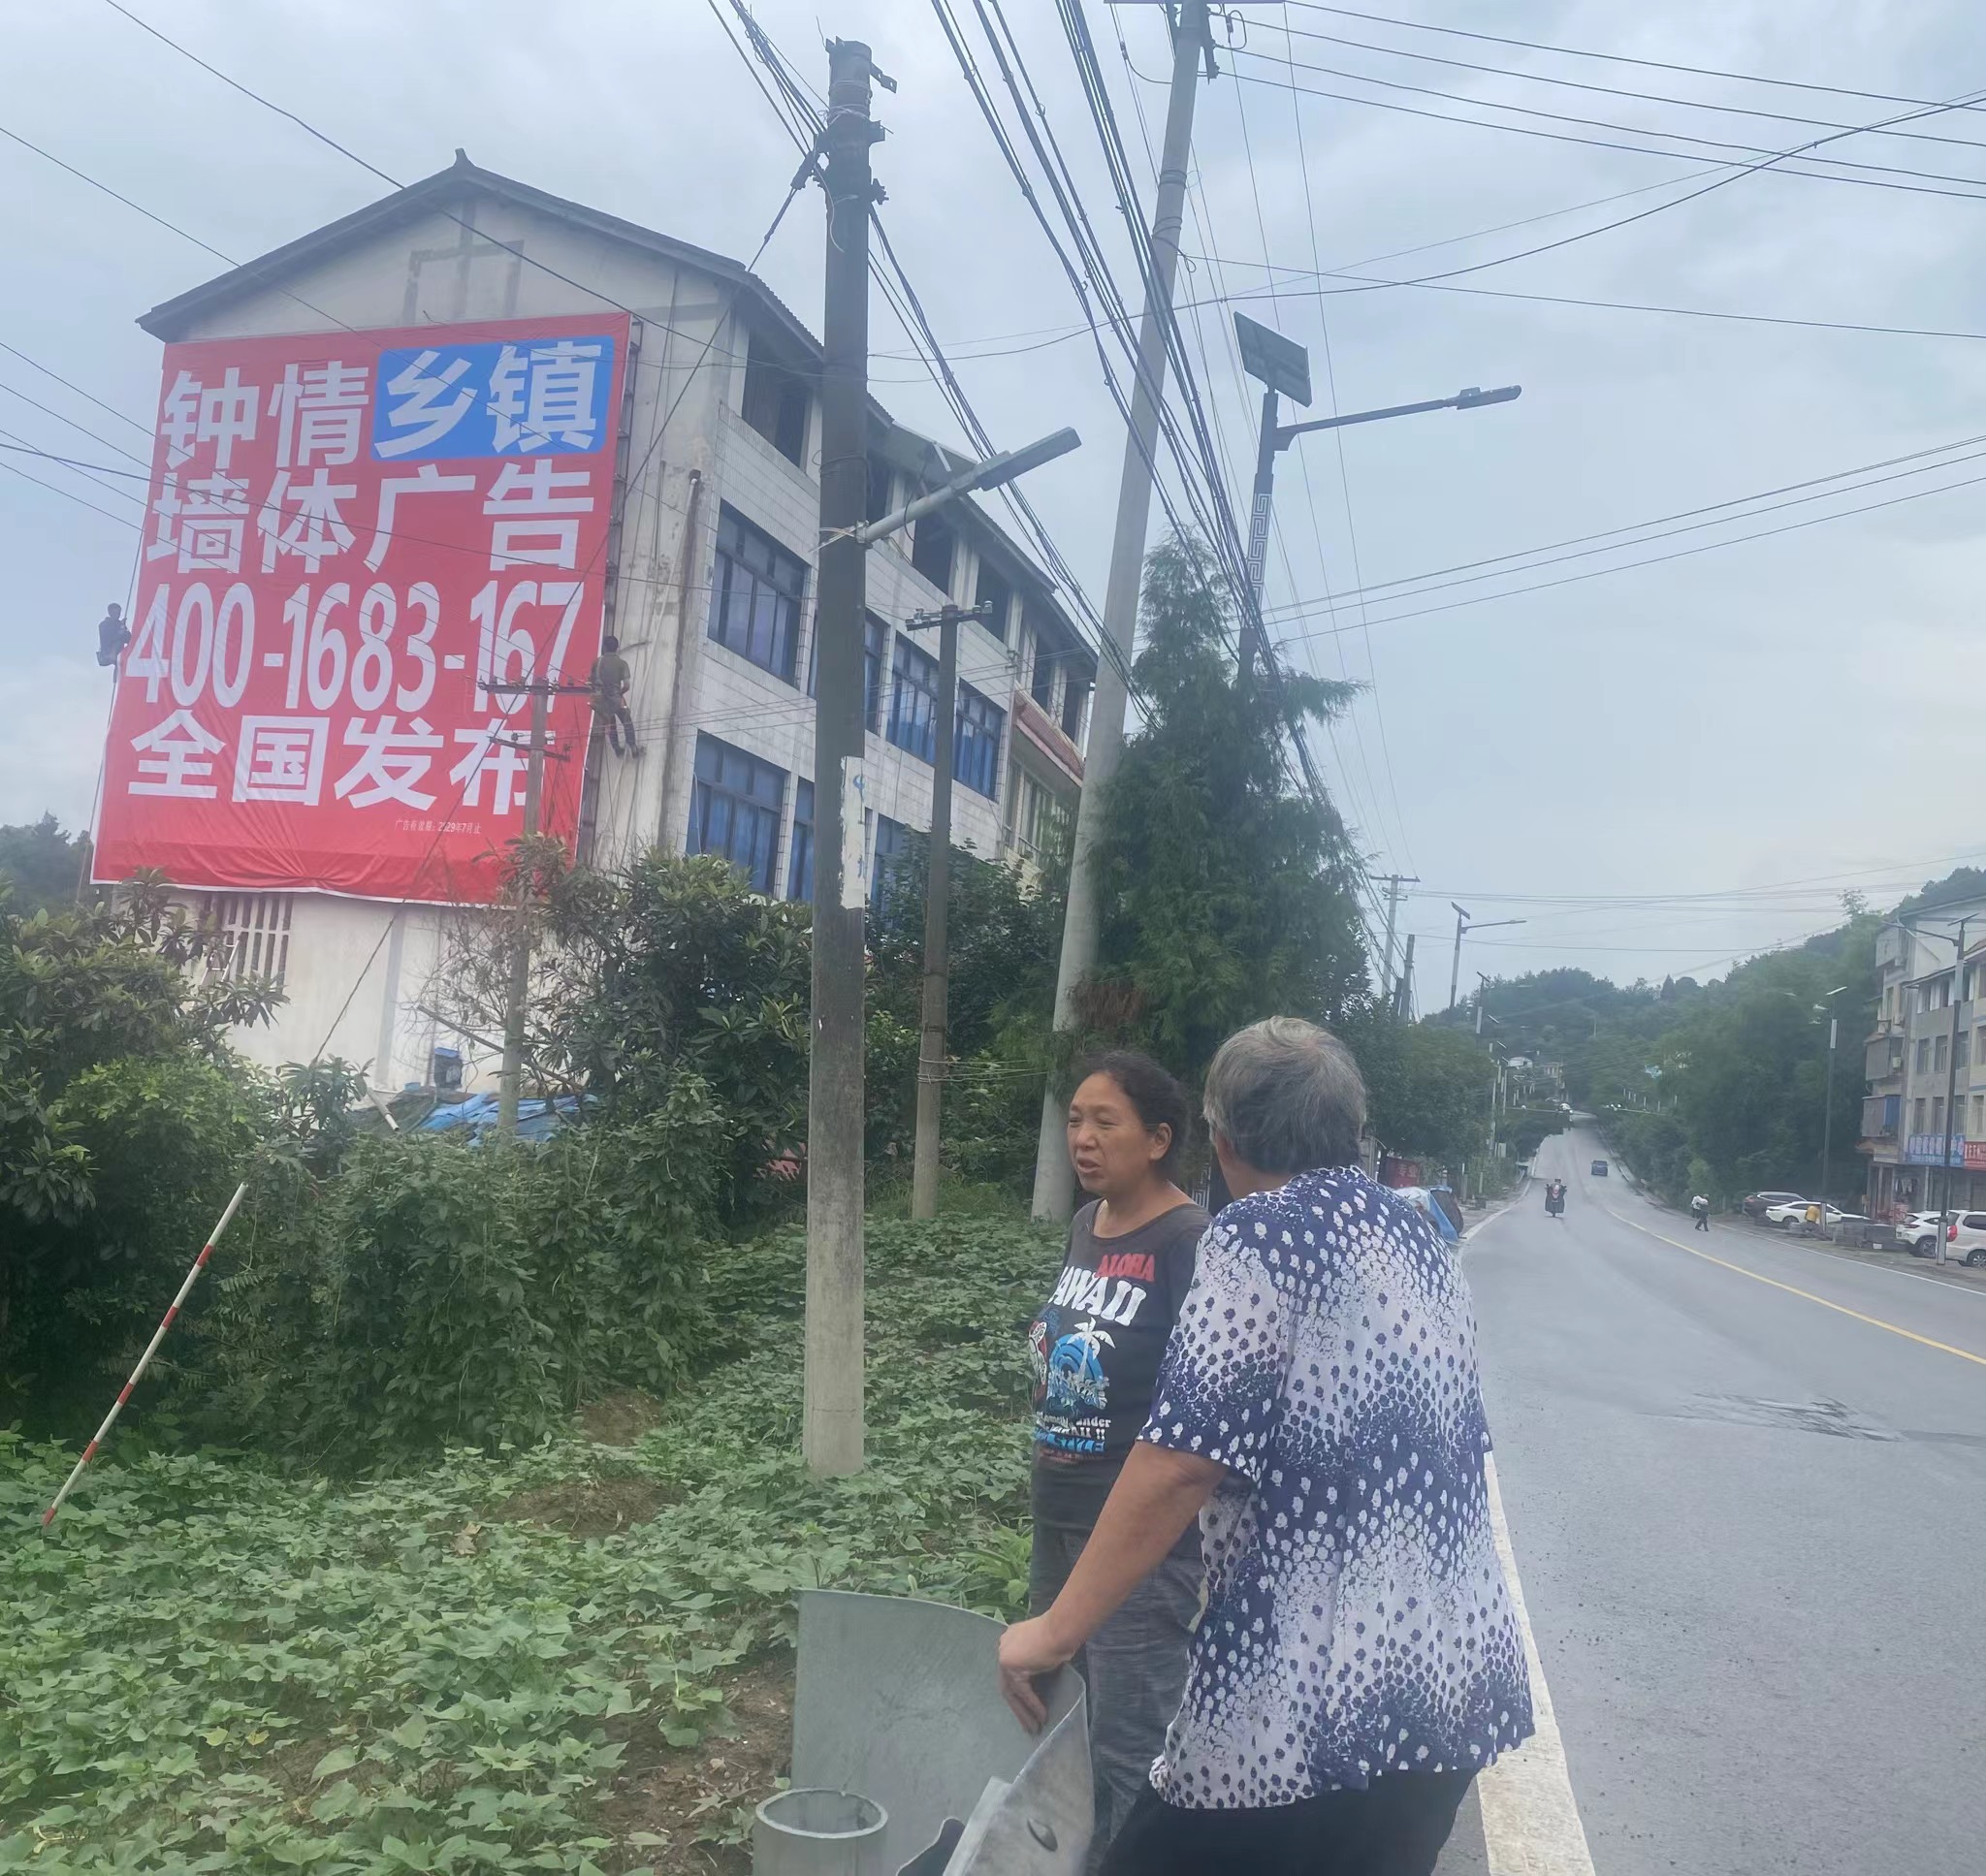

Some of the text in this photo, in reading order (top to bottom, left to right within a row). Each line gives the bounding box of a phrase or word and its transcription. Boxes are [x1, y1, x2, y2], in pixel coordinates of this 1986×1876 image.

[161, 341, 602, 469] 钟情乡镇
[146, 459, 594, 574] 墙体广告
[126, 580, 585, 715] 400-1683-167
[127, 709, 556, 815] 全国发布
[1048, 1266, 1147, 1327] AWAII
[1096, 1253, 1155, 1283] ALOHA
